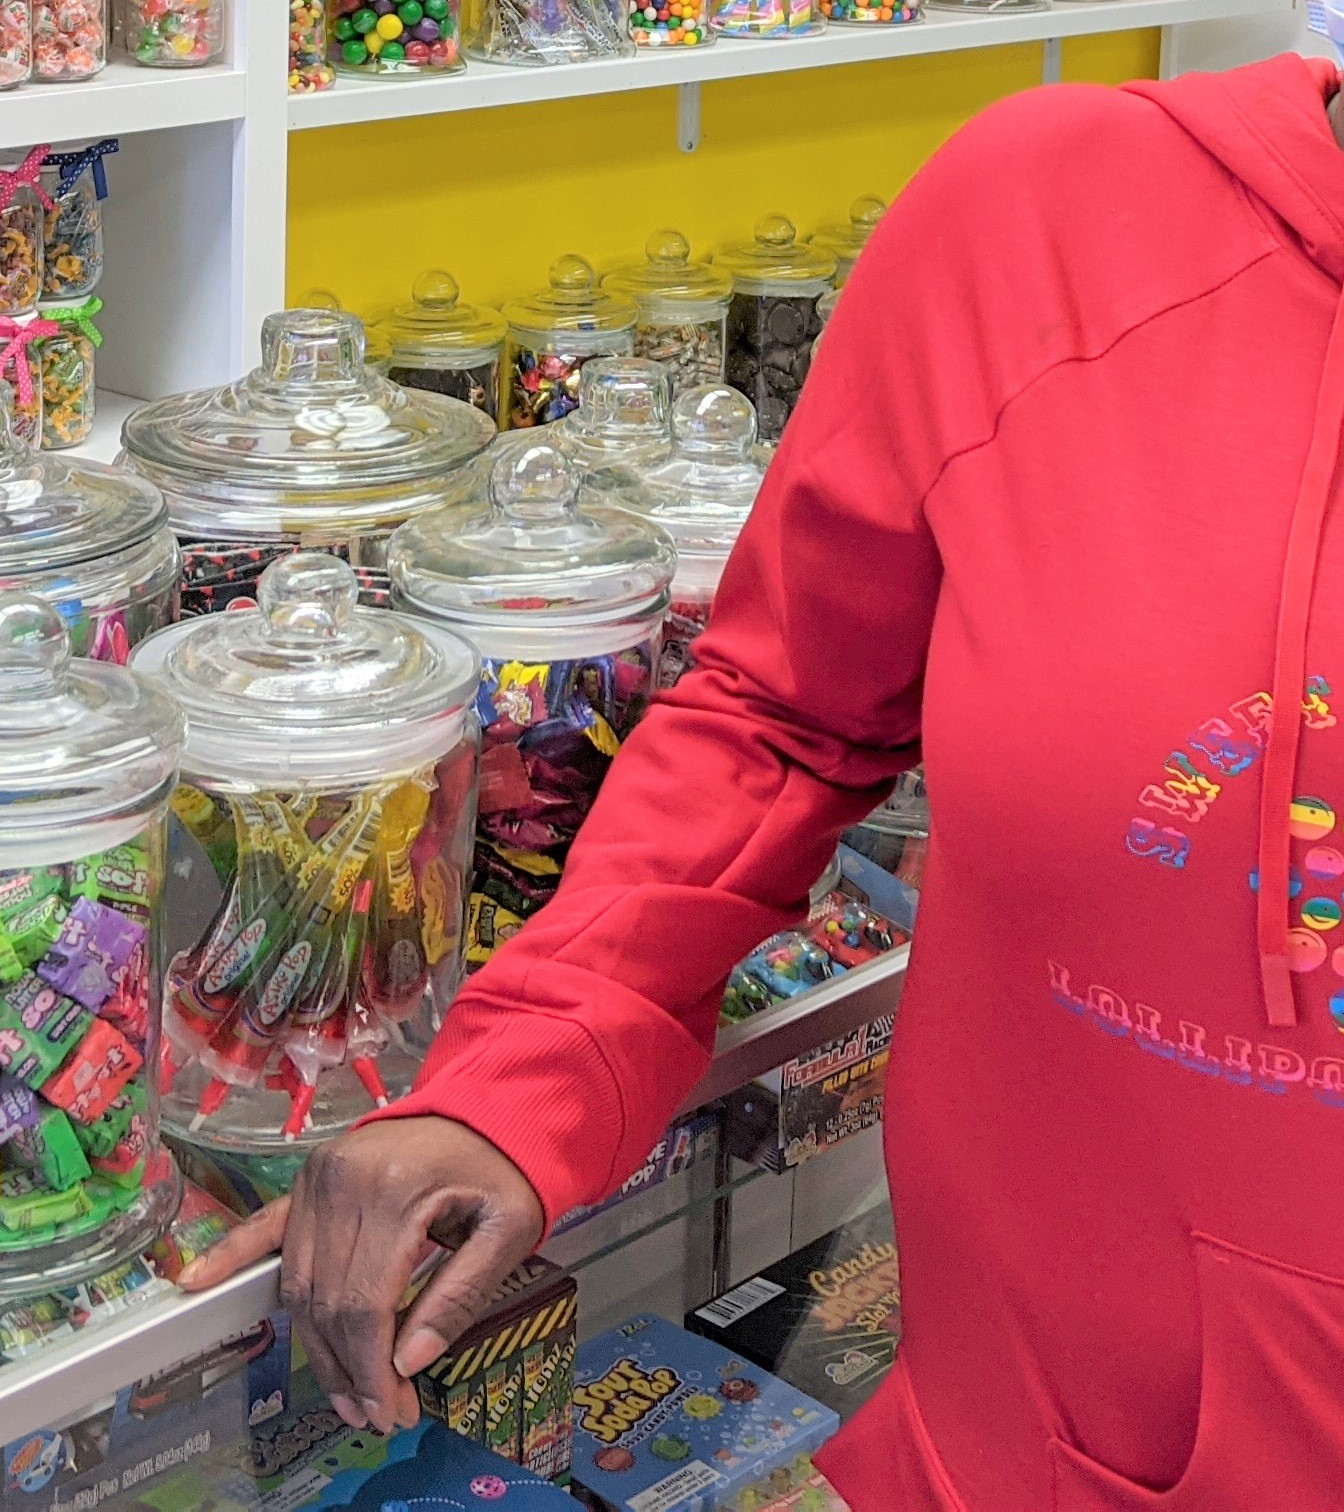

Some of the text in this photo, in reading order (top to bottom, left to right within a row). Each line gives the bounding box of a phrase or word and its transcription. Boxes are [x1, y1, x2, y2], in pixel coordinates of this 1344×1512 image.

[573, 1358, 642, 1416] Sour
[582, 1367, 682, 1444] Soda Pop
